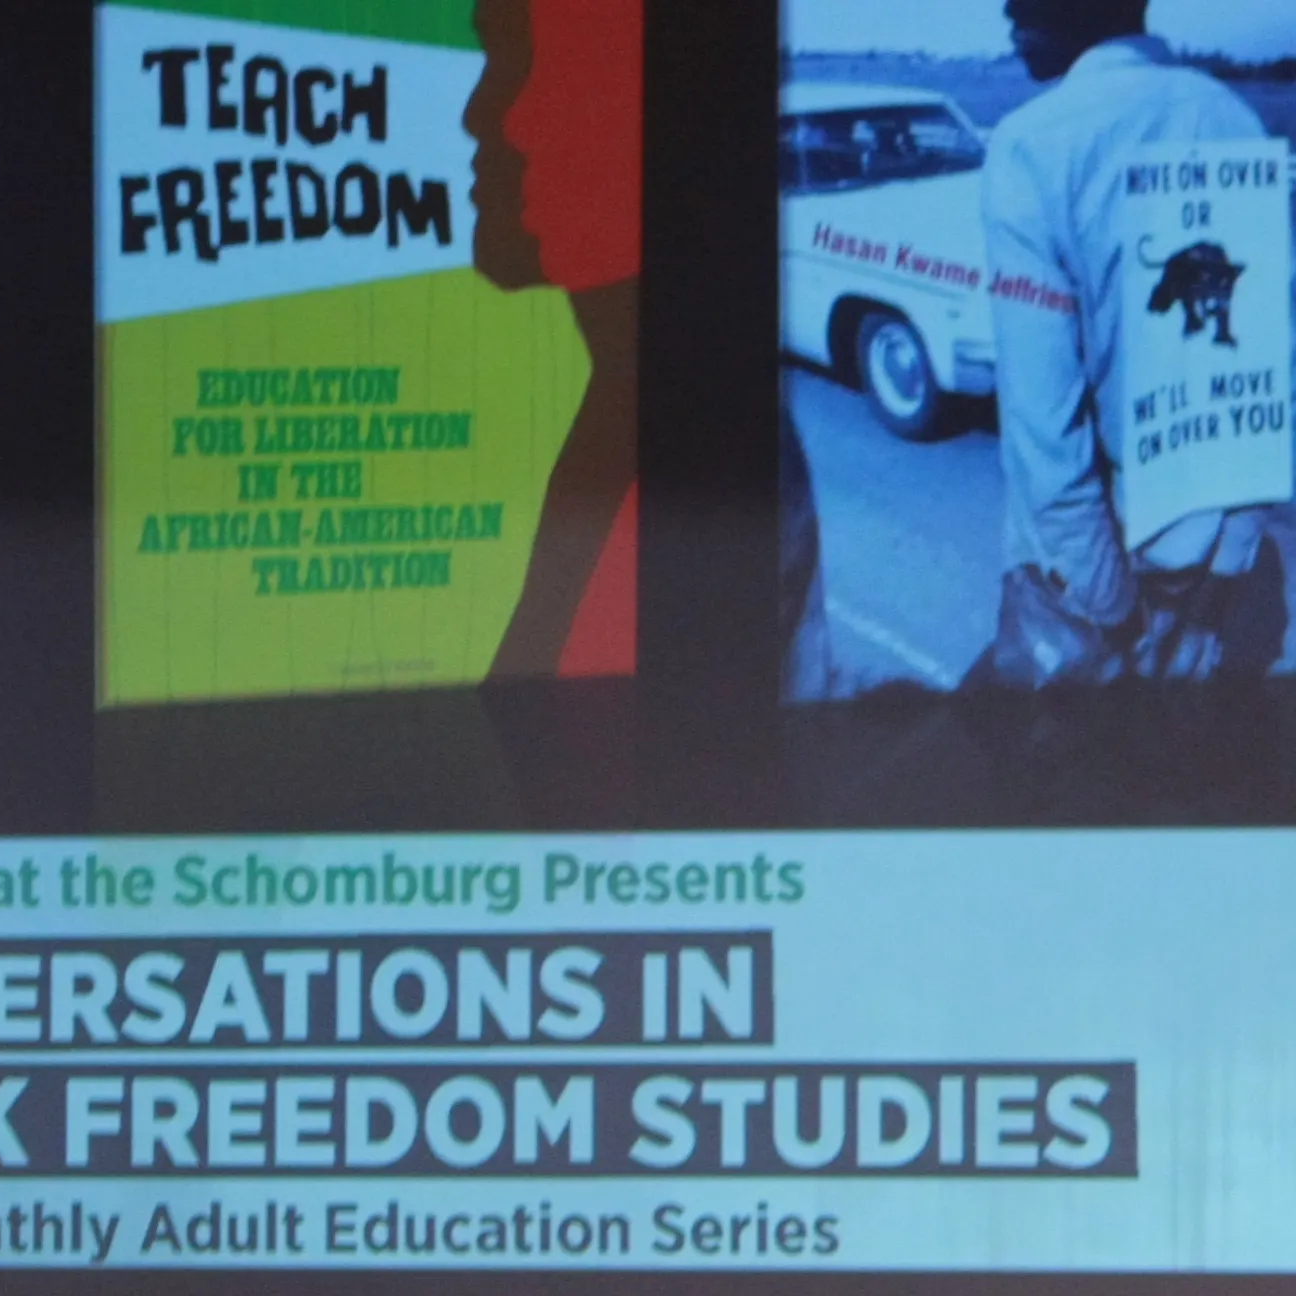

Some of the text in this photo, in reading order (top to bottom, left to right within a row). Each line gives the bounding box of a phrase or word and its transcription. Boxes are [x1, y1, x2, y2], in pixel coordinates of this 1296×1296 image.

[142, 43, 387, 145] TEACH
[1126, 159, 1278, 195] MOVE ON OVER
[120, 158, 452, 263] FREEDOM
[1182, 201, 1211, 229] OR
[812, 221, 1077, 314] Hasan Kwame Jeffries
[196, 367, 400, 409] EDUCATION
[1211, 368, 1273, 400] MOVE
[172, 410, 471, 457] FOR LIBERATION
[1138, 401, 1284, 465] ON OVER YOU
[238, 459, 362, 501] IN THE
[137, 503, 502, 554] AFRICAN-AMERICAN
[253, 551, 451, 597] TRADITION
[60, 854, 155, 906] the
[174, 852, 520, 914] Schomburg
[545, 852, 804, 903] Presents
[643, 946, 753, 1042] IN
[65, 1074, 594, 1168] FREEDOM
[628, 1074, 1112, 1169] STUDIES
[140, 1200, 303, 1254] Adult
[326, 1199, 630, 1255] Education
[653, 1201, 839, 1255] Series
